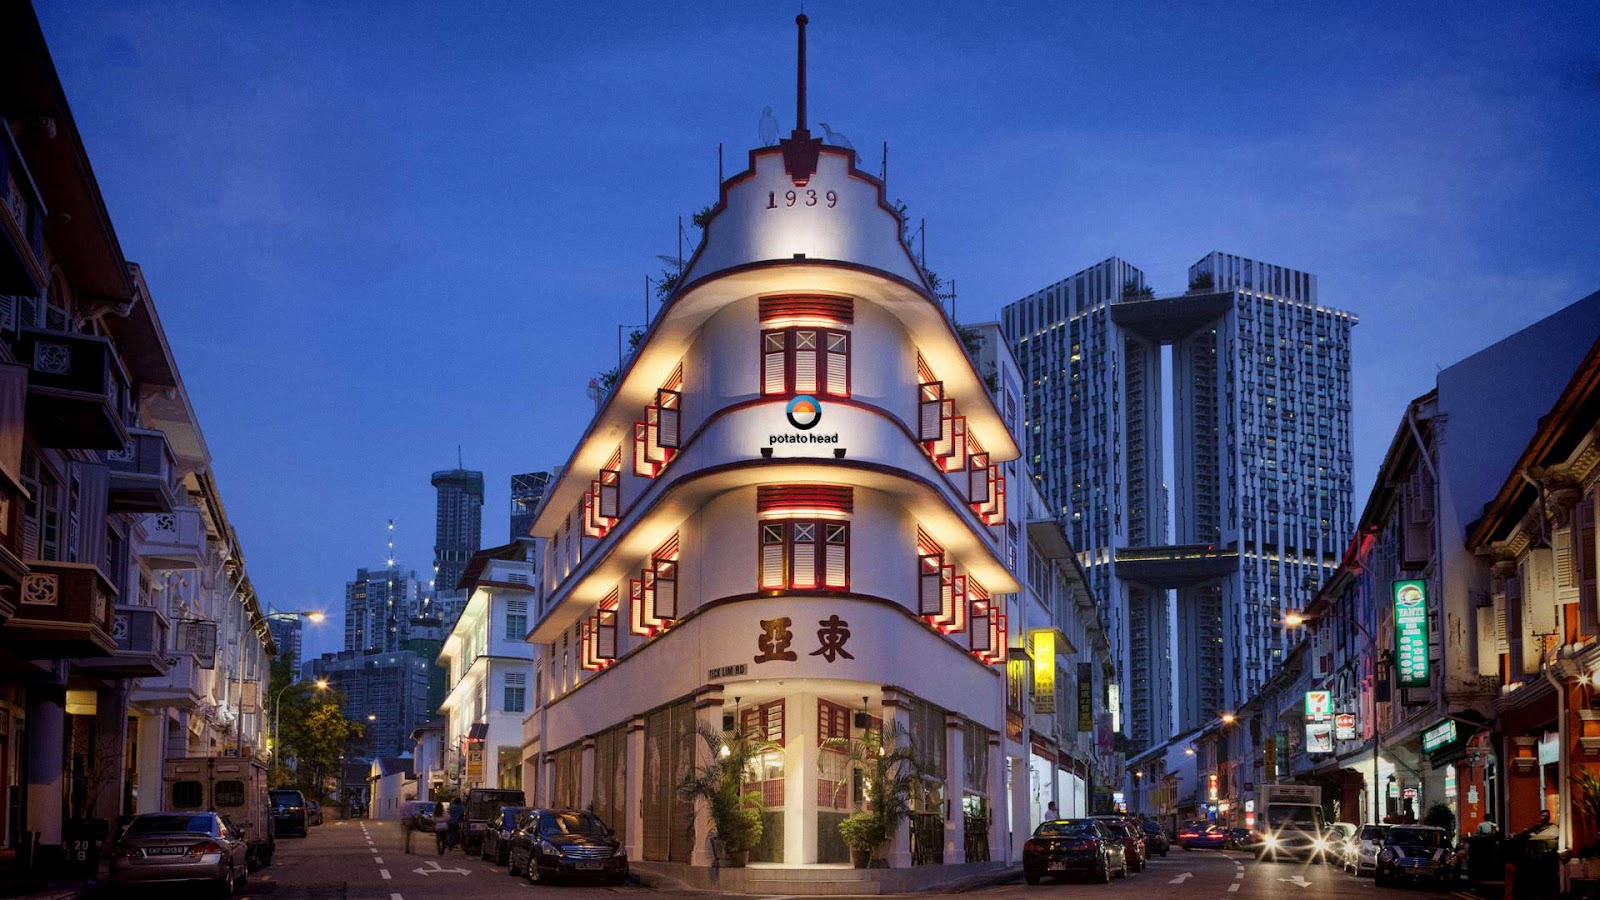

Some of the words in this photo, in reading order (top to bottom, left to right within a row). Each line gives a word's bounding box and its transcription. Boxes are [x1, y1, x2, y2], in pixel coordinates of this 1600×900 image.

[766, 189, 837, 209] 1939
[769, 433, 808, 445] potato
[809, 433, 838, 443] head
[709, 667, 721, 680] TECK
[722, 666, 733, 677] LIM
[735, 664, 745, 675] RD
[74, 840, 89, 851] 20
